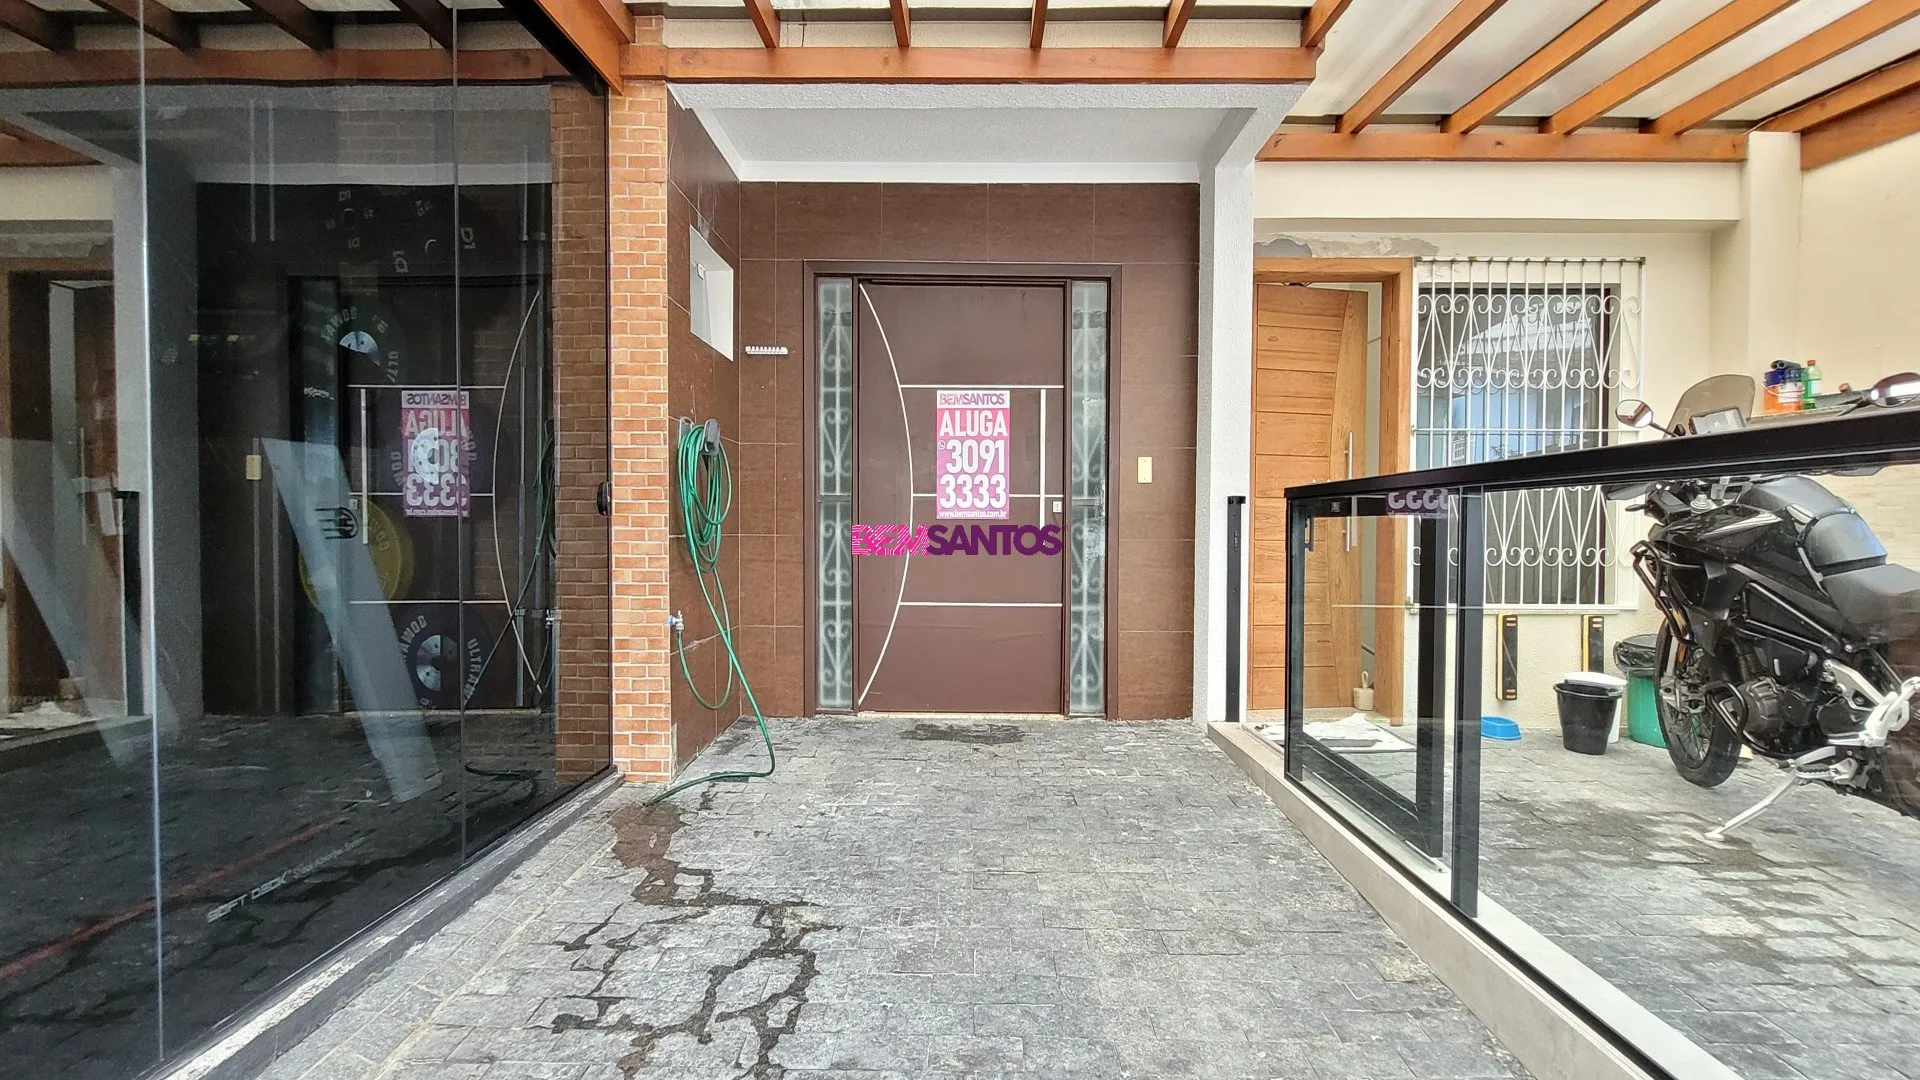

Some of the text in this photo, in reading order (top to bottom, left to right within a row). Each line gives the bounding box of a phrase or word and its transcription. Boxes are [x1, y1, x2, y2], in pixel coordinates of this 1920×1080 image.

[940, 393, 1005, 406] BEMSANTOS
[940, 409, 1008, 437] ALUGA
[945, 439, 1005, 474] 3091
[939, 473, 1007, 509] 3333
[938, 509, 1008, 518] www.bemsantos.com.br
